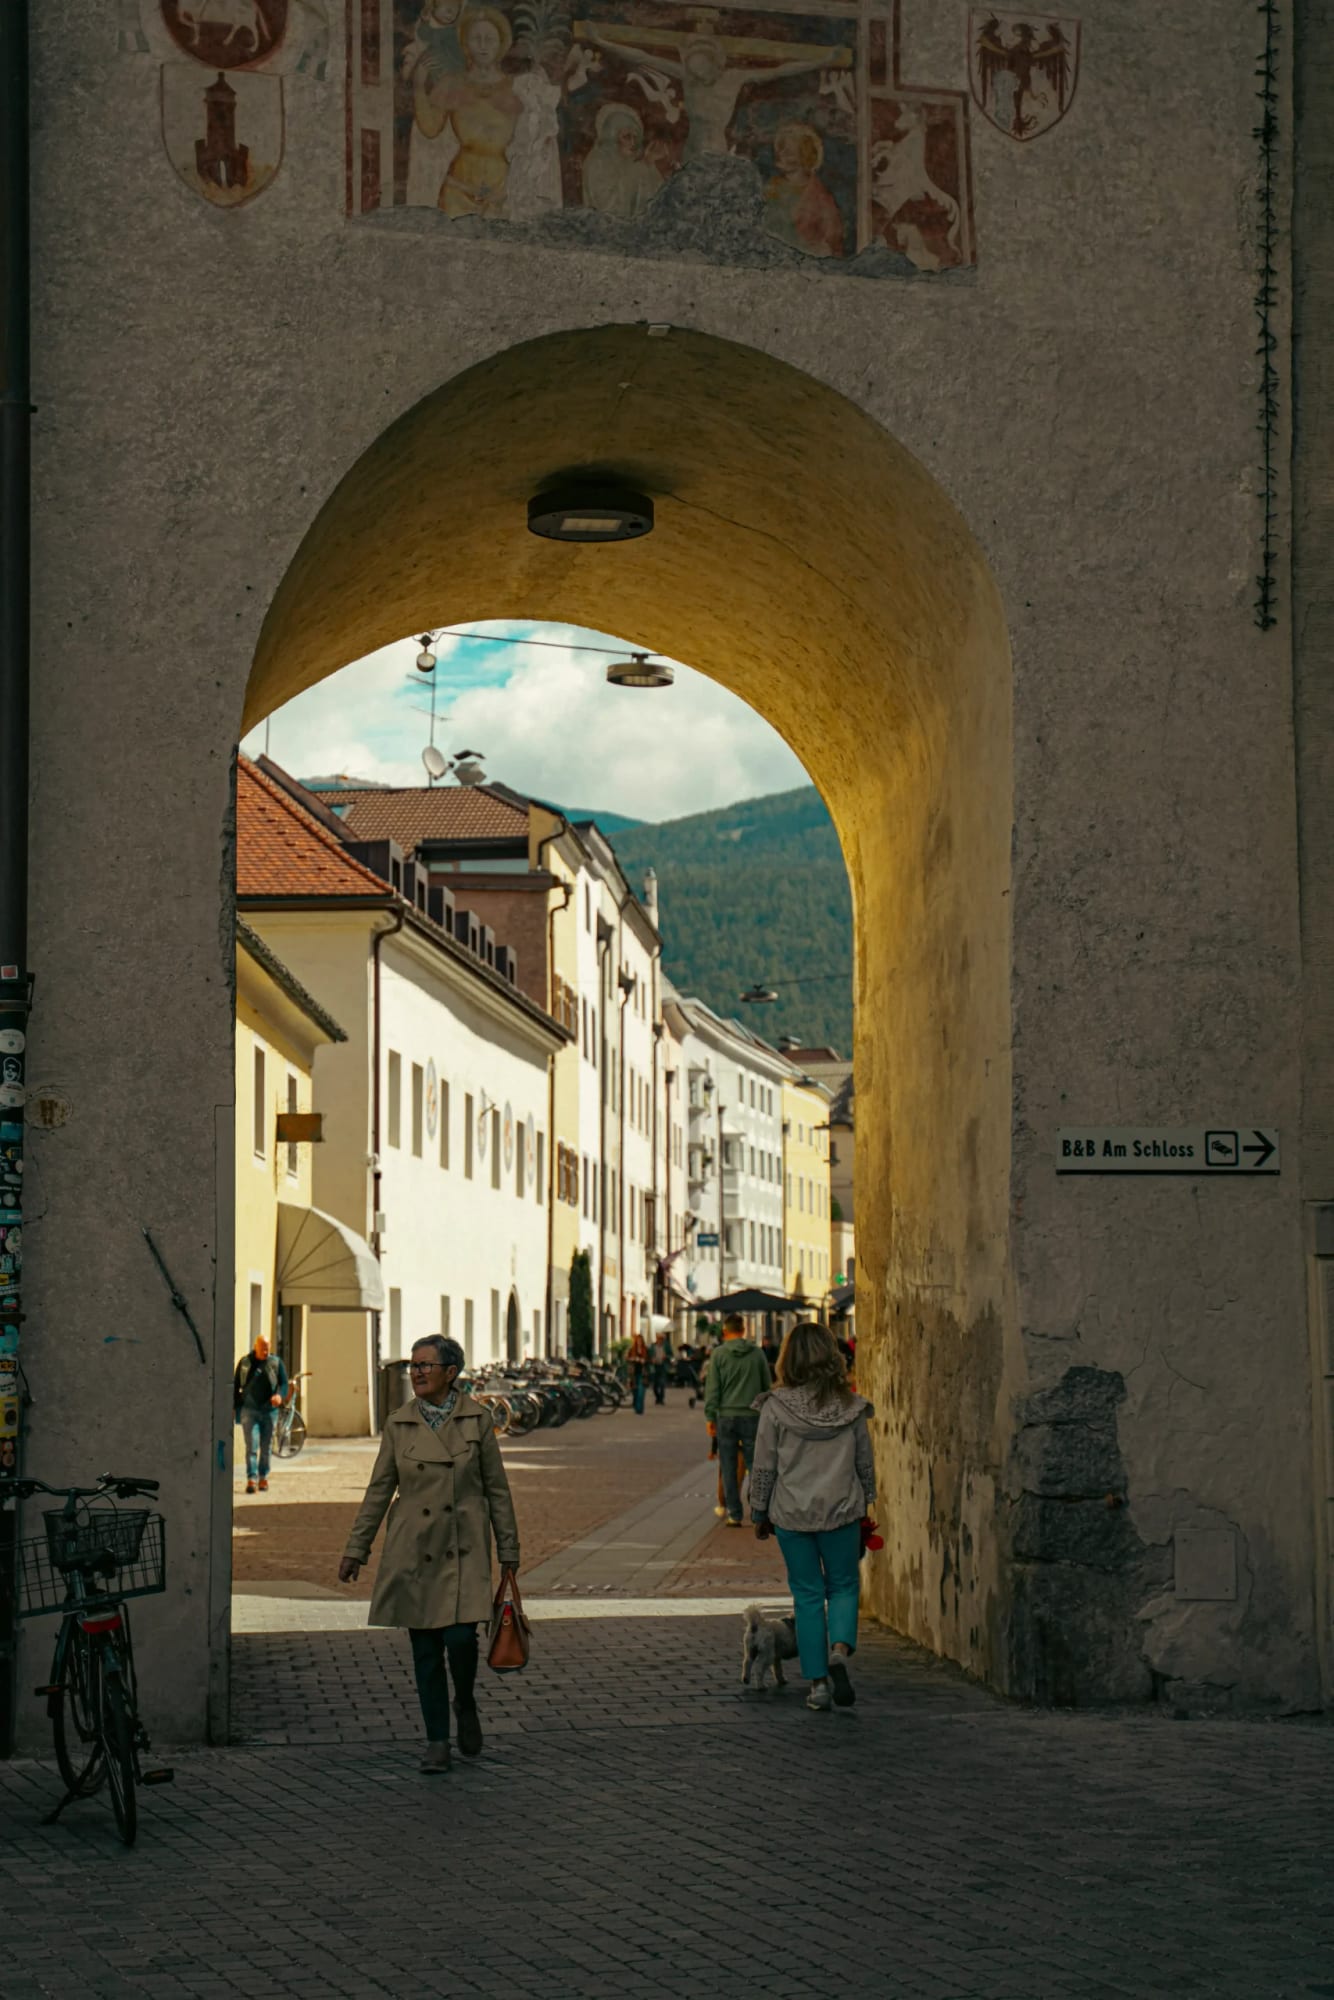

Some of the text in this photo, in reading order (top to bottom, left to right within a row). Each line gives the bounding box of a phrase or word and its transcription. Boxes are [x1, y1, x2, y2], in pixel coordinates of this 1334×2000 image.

[1062, 1139, 1194, 1157] B&B Am Schloss
